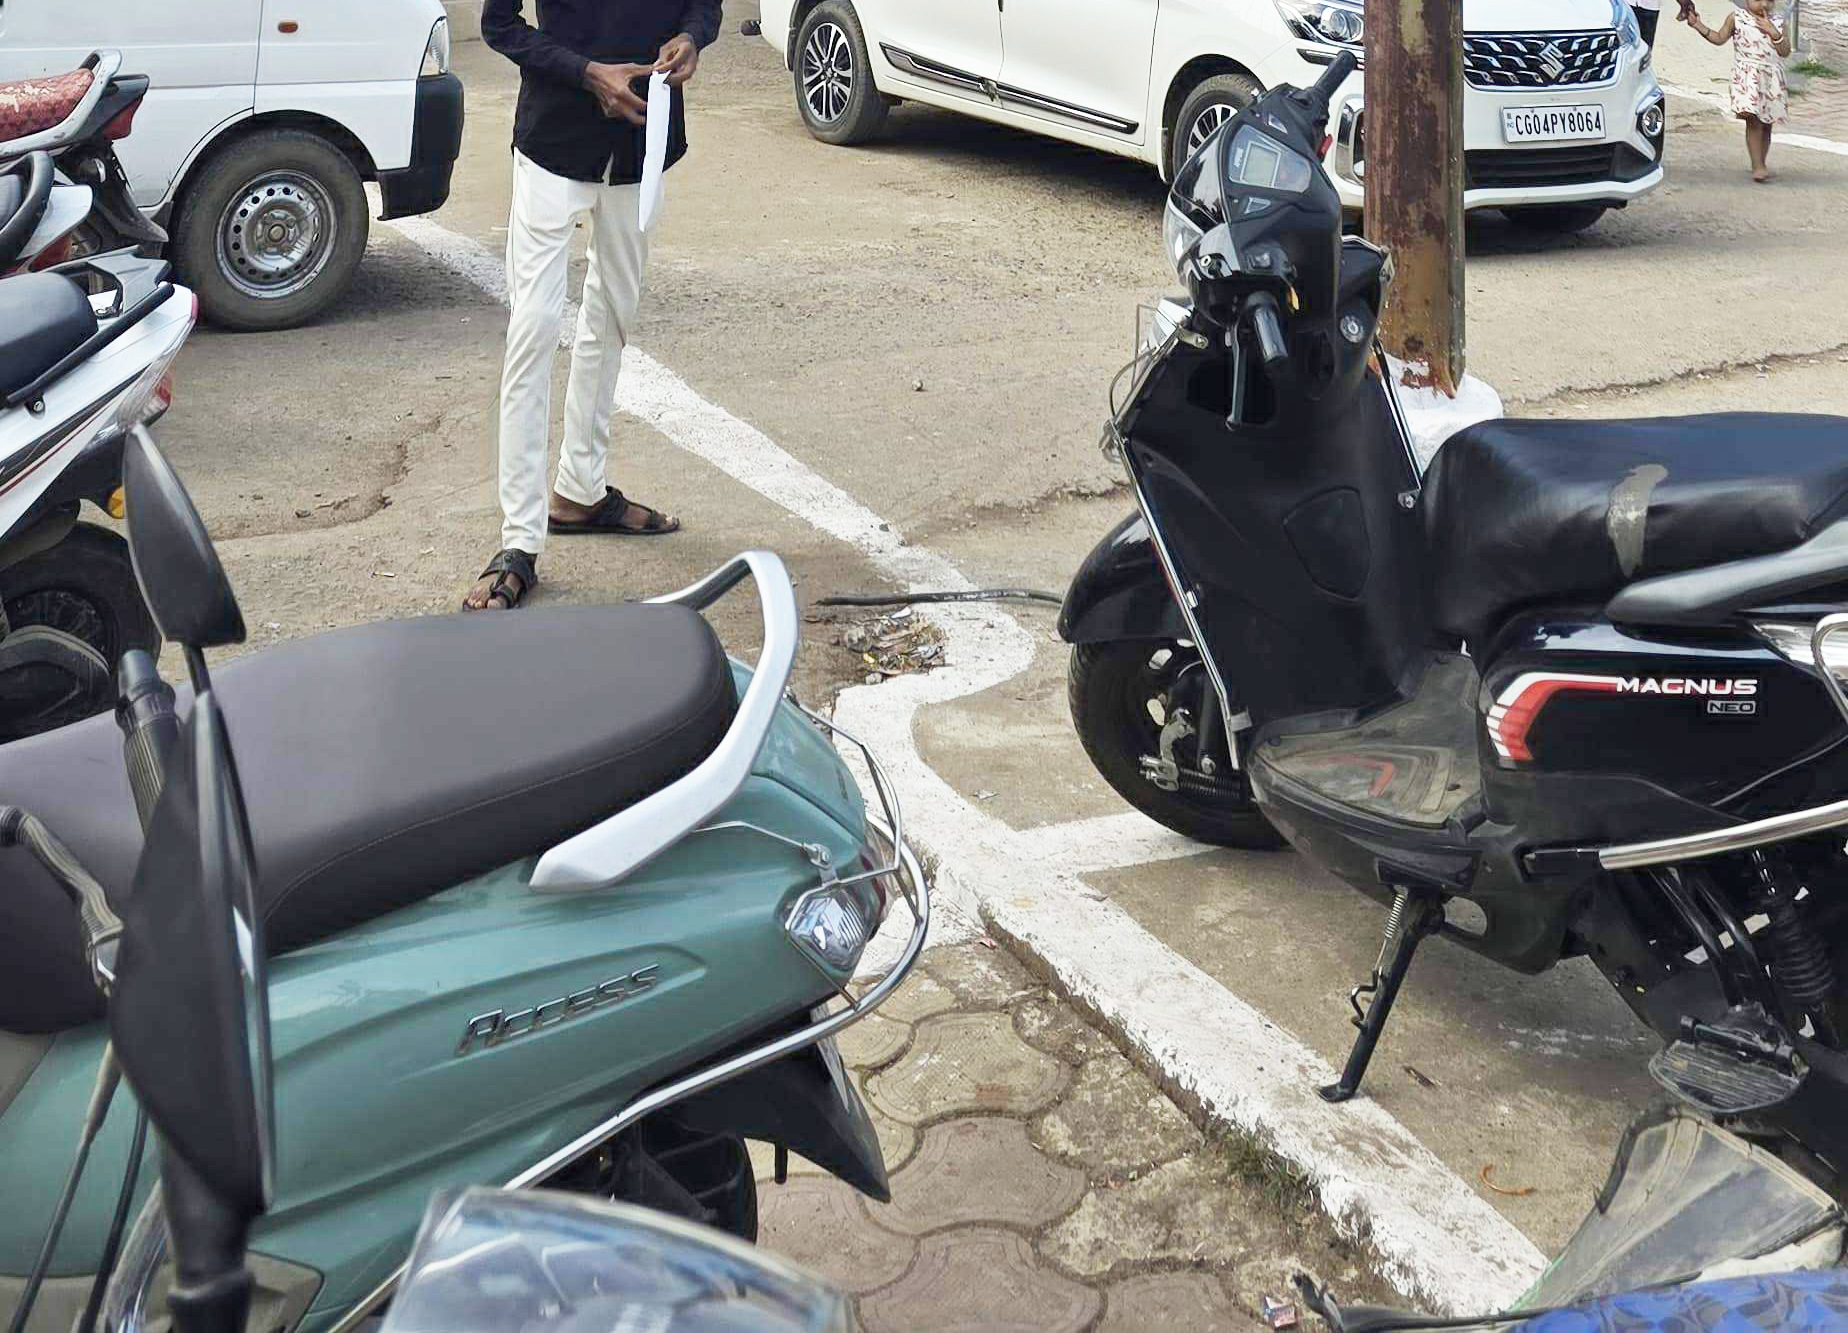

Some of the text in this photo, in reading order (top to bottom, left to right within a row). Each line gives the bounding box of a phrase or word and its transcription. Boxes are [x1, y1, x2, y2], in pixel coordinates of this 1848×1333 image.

[1515, 111, 1602, 136] CG04PY8064
[1616, 676, 1758, 695] MAGNUS
[1709, 701, 1755, 714] NEO
